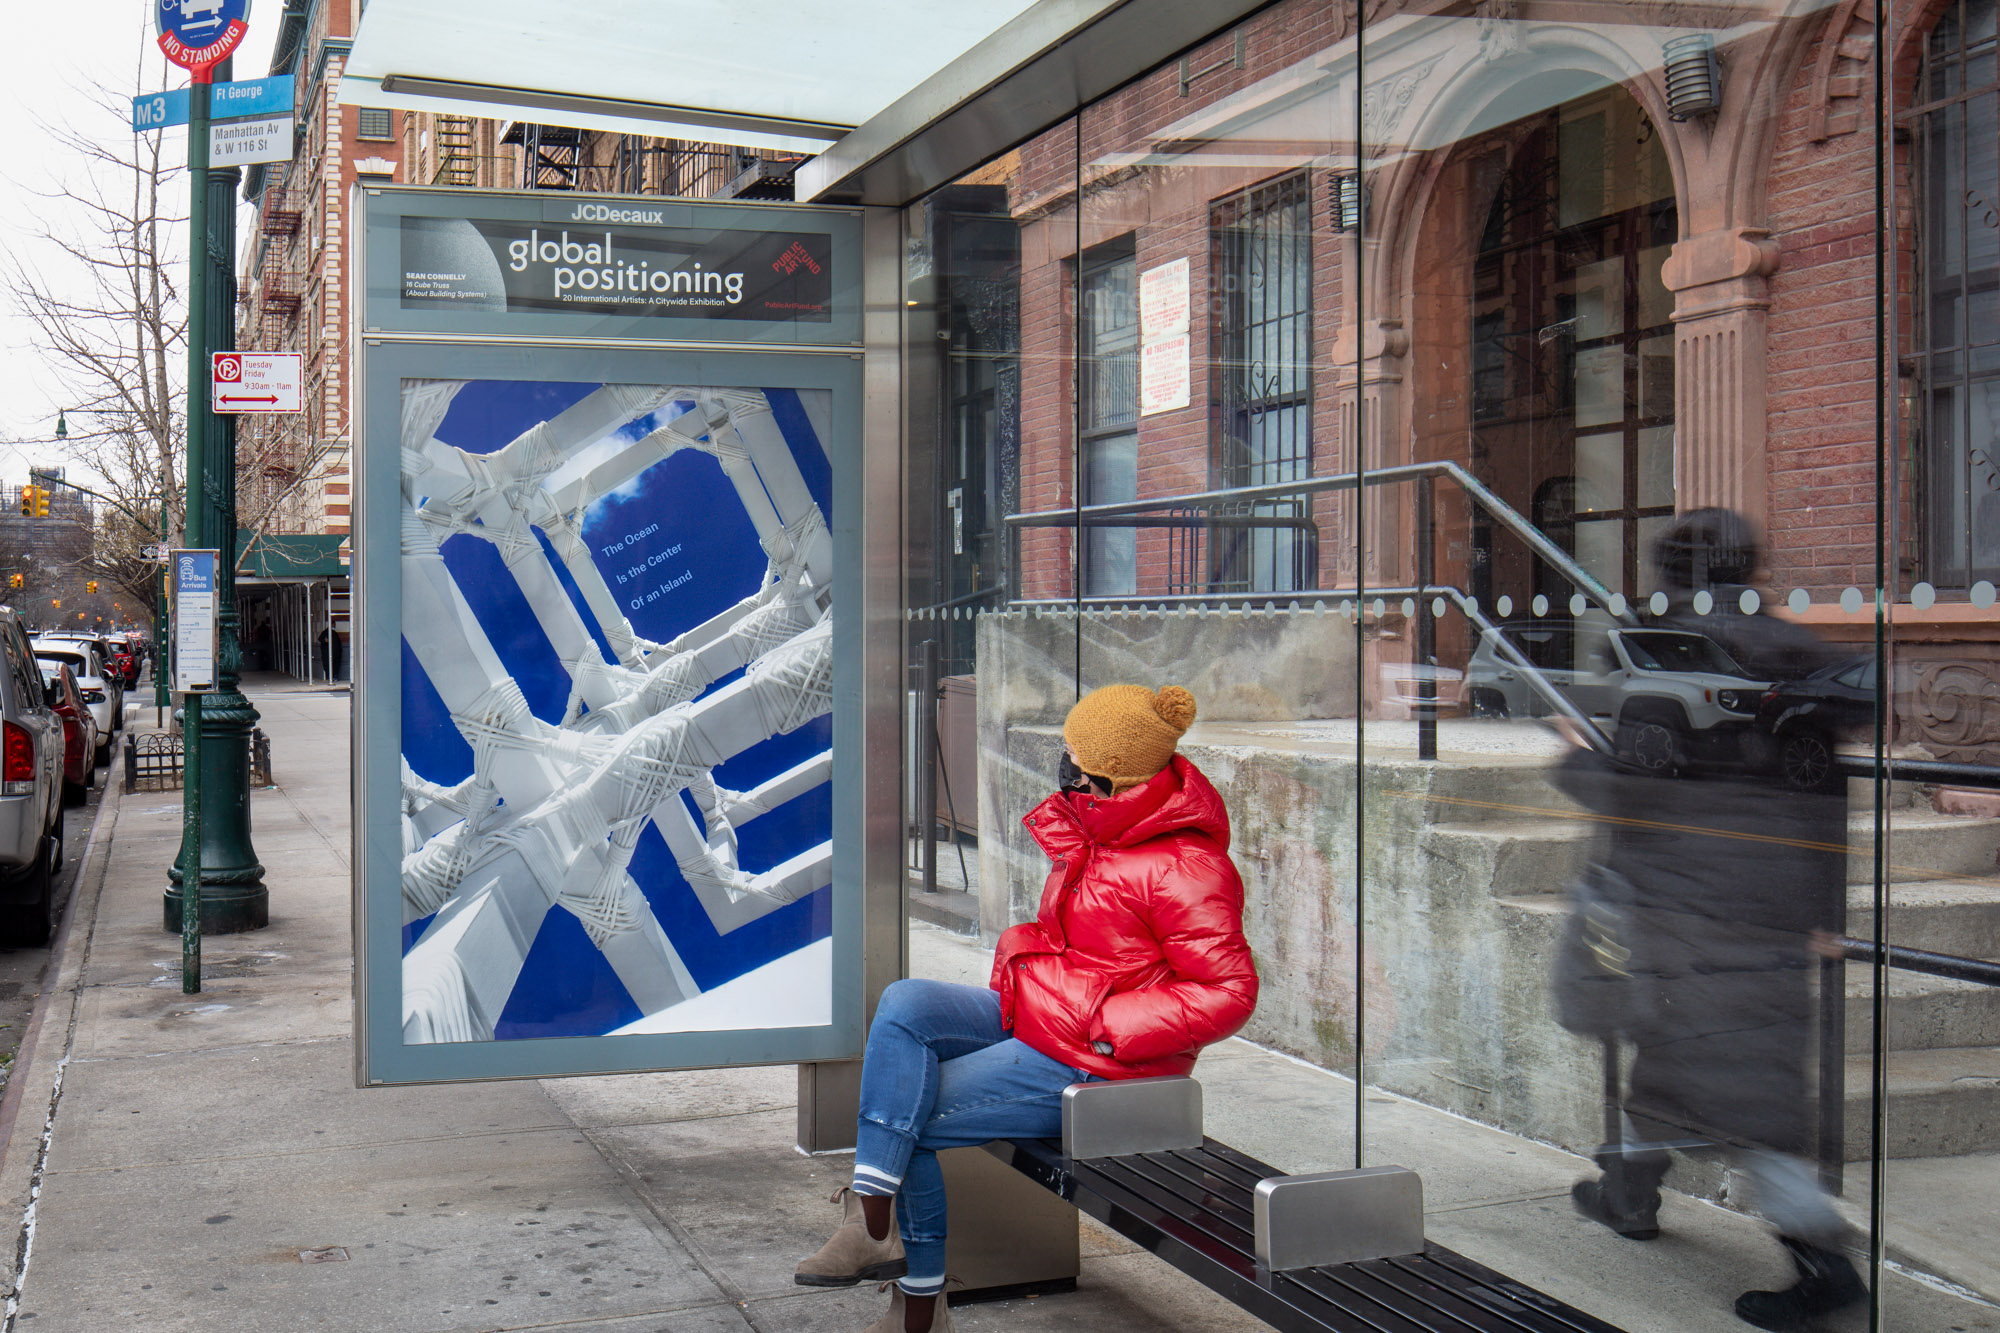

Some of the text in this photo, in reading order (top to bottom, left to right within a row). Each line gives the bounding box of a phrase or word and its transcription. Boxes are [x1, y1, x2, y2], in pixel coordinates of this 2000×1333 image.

[164, 24, 239, 64] NO STANDING
[217, 86, 262, 100] Ft George
[136, 97, 166, 126] M3
[215, 123, 278, 140] Manhattan Av
[215, 140, 267, 155] & W 116 St
[572, 204, 663, 224] JCDecaux
[508, 229, 612, 272] global
[772, 241, 802, 273] PUBLIC
[785, 256, 802, 275] ART
[799, 249, 821, 275] FUND
[554, 260, 744, 304] positioning
[406, 289, 487, 298] (About Building Systems)
[574, 295, 619, 303] International
[621, 295, 647, 304] Artists:
[656, 297, 687, 306] Citywide
[765, 301, 822, 311] PublicArtFund.org
[1154, 338, 1184, 353] TRESPASSING
[245, 370, 265, 378] Friday
[602, 523, 659, 557] The Ocean
[616, 543, 682, 584] Is the Center
[631, 570, 693, 610] Of an Island
